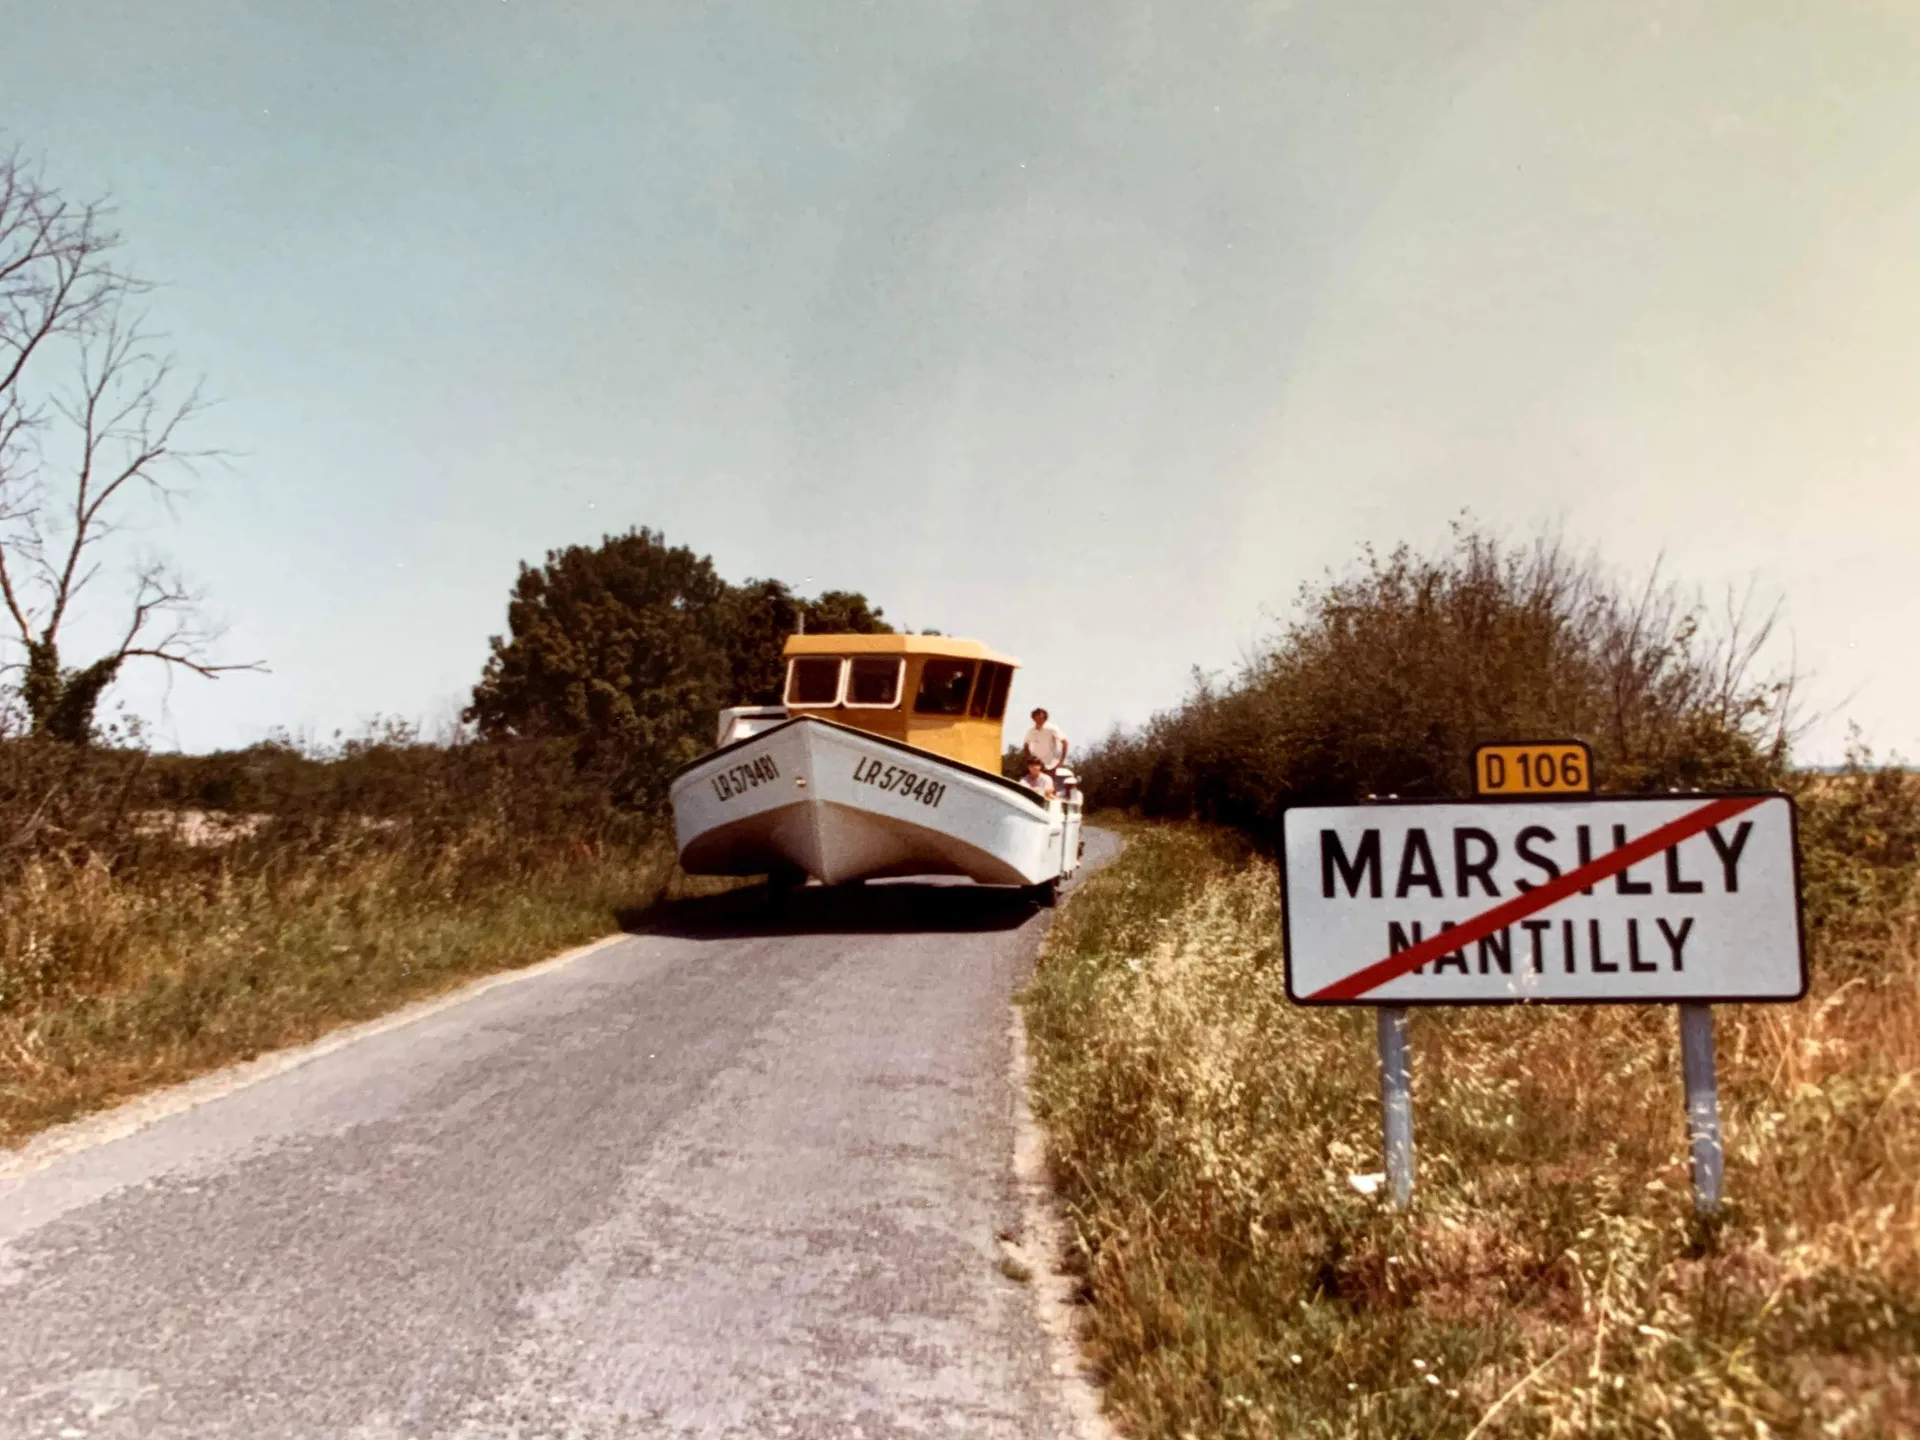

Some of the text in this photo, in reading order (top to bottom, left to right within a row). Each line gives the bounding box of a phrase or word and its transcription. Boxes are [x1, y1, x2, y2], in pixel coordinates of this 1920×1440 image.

[1486, 753, 1582, 788] D 106
[1320, 821, 1753, 898] MARSILLY
[1388, 917, 1694, 974] NANTILLY
